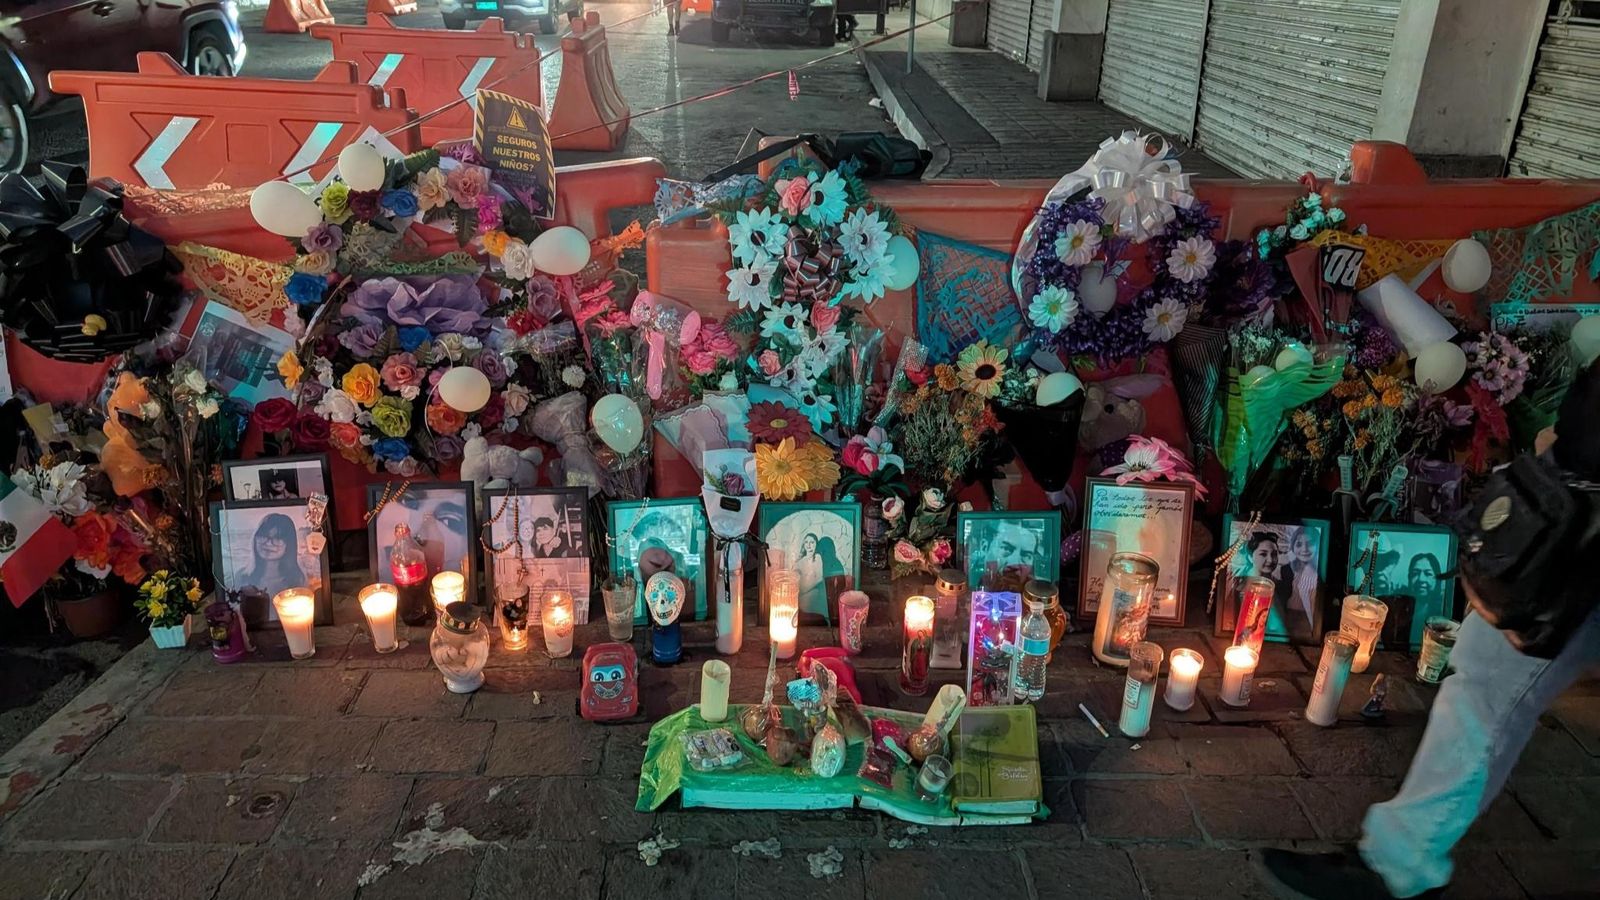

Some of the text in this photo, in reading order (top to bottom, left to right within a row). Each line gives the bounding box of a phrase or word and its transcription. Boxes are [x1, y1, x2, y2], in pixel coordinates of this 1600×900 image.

[496, 134, 538, 150] SEGUROS
[492, 146, 541, 162] NUESTROS
[499, 158, 534, 173] NIÑOS?
